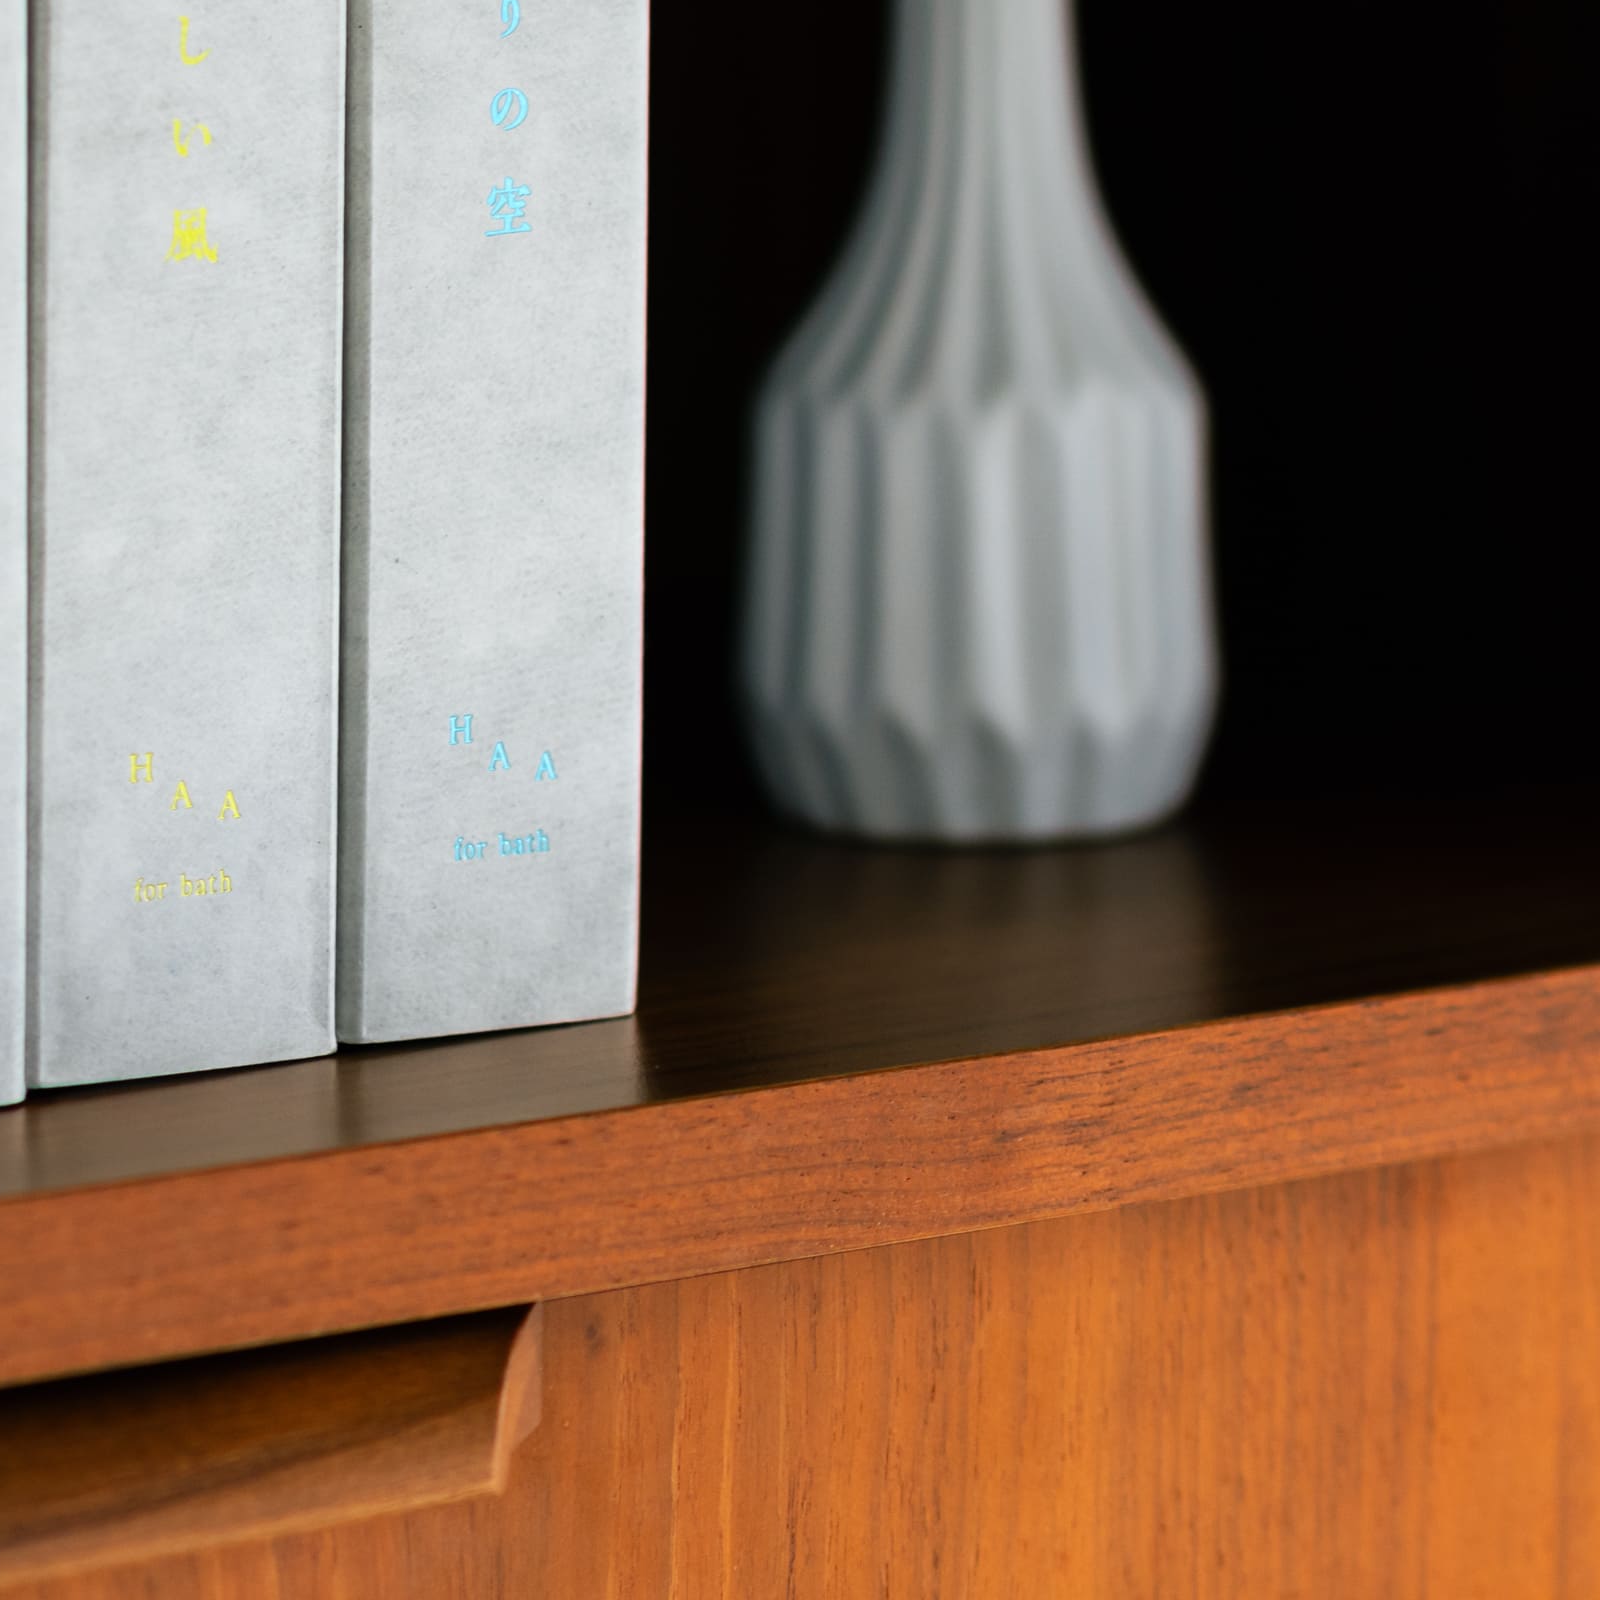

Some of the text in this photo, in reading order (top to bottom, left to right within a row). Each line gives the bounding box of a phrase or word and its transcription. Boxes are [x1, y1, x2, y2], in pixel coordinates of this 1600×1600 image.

[453, 828, 550, 862] for bath
[133, 869, 233, 903] for bath
